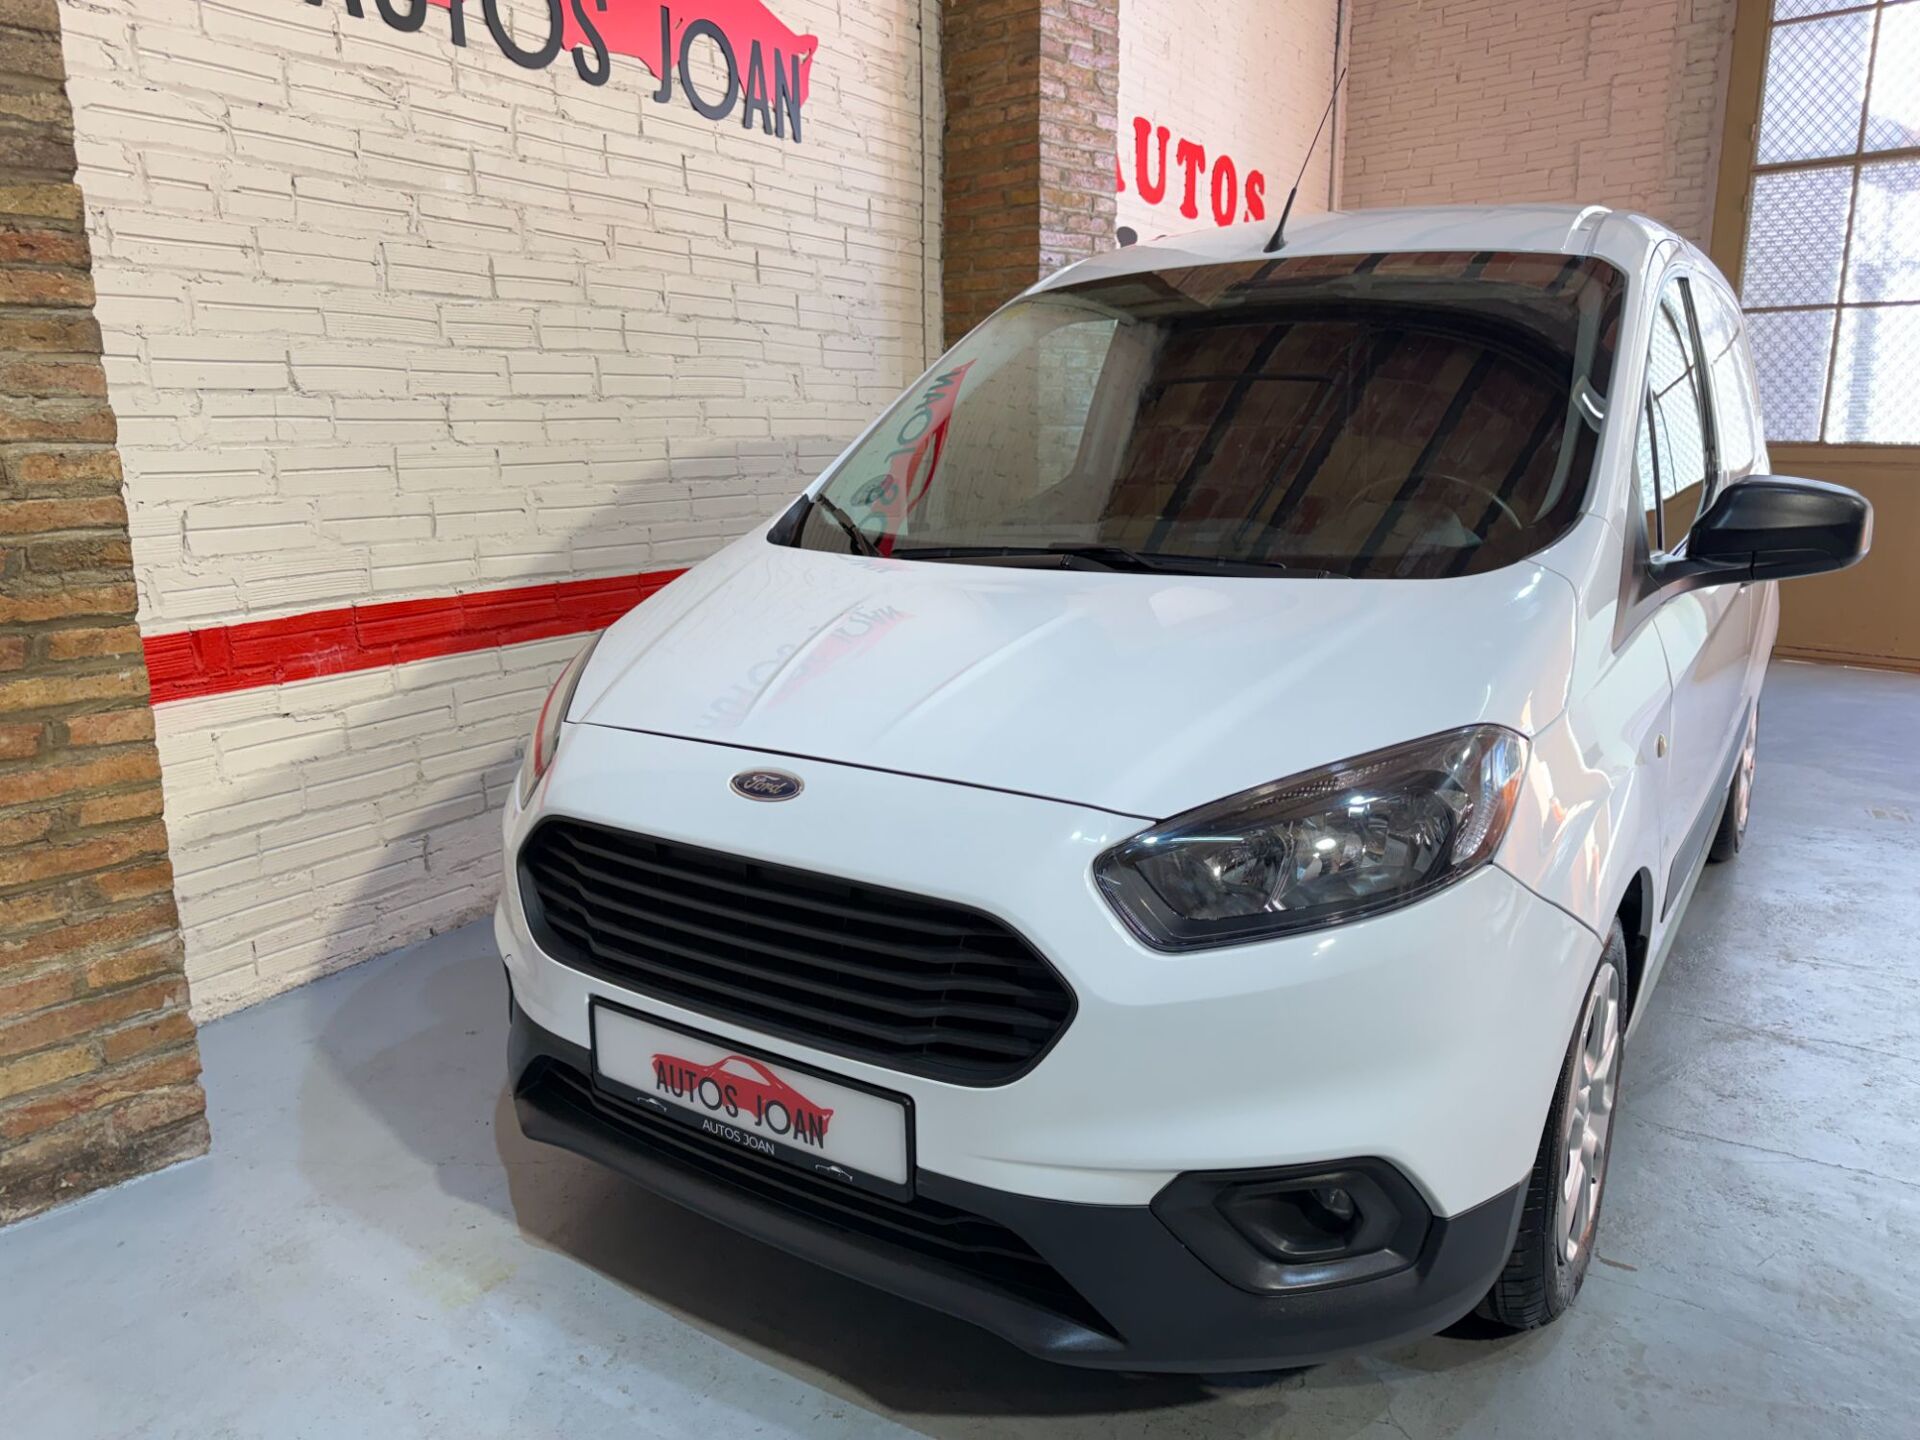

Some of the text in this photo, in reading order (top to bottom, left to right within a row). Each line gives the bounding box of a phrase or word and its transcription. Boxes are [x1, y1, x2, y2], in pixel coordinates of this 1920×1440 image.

[654, 5, 801, 143] JOAN
[1116, 116, 1266, 228] UTOS
[743, 775, 787, 794] Ford
[656, 1060, 824, 1149] AUTOS JOAN
[702, 1119, 775, 1156] AUTOS JOAN
